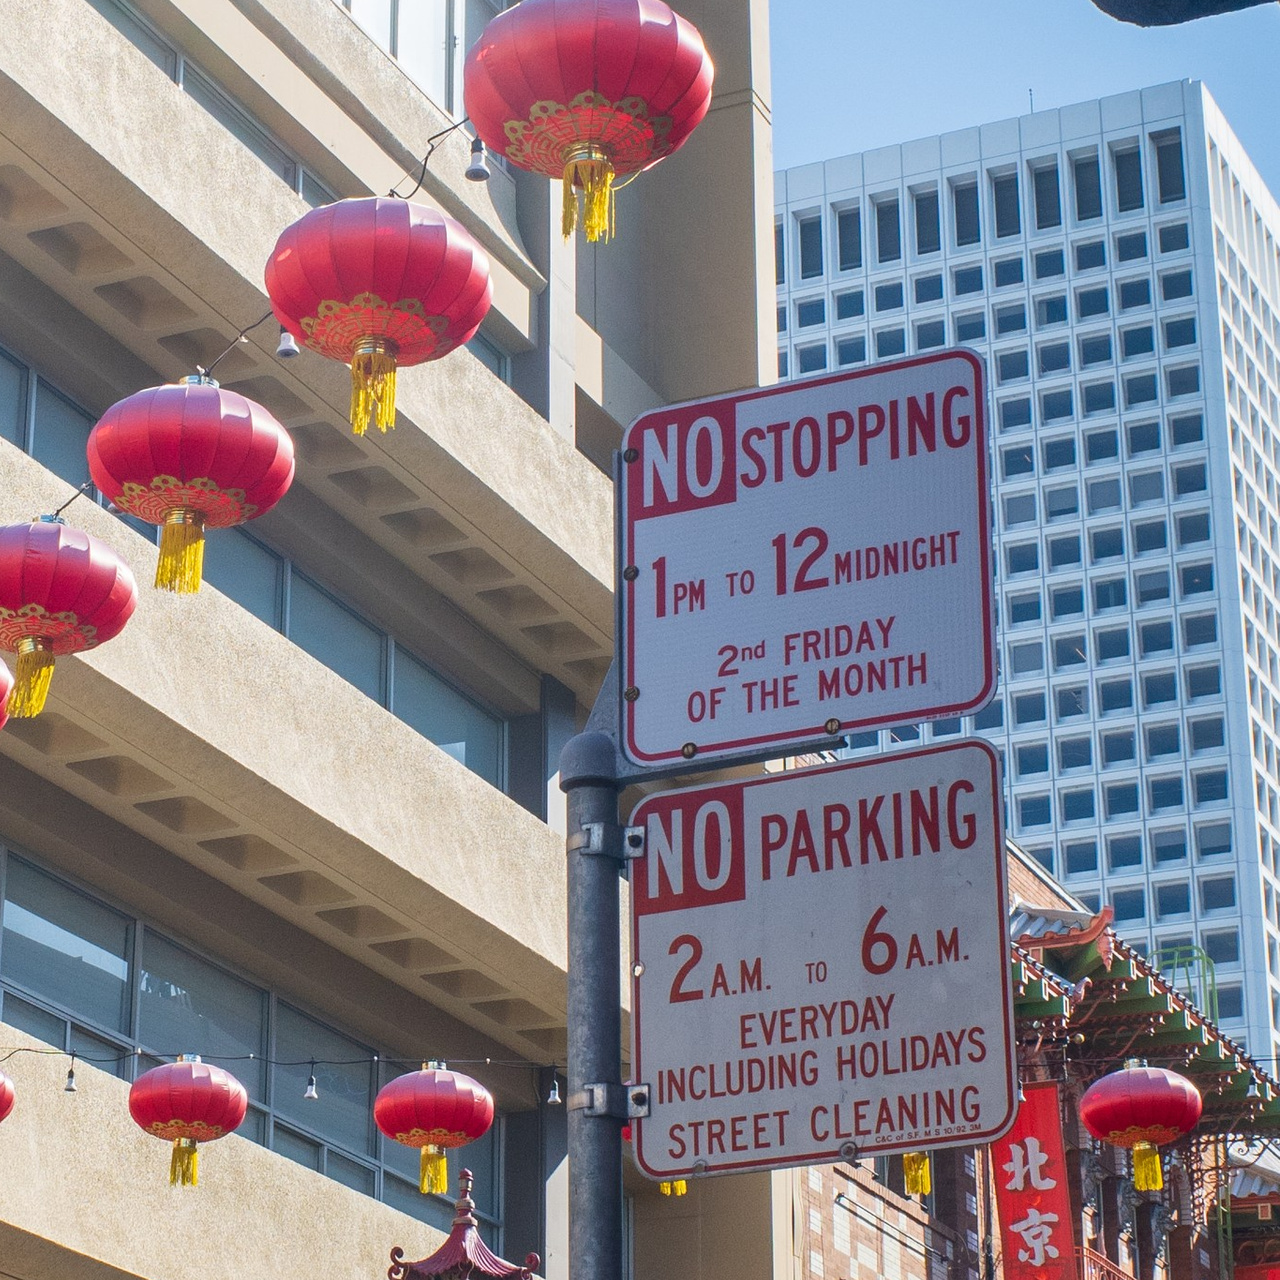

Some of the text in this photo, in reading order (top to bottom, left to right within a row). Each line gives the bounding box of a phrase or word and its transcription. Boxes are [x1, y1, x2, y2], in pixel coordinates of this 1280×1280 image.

[643, 385, 971, 508] NO STOPPING
[726, 570, 755, 596] TO
[717, 616, 896, 677] 2nd FRIDAY
[688, 652, 927, 722] OF THE MONTH
[647, 779, 977, 899] NO PARKING
[805, 962, 827, 984] TO
[740, 993, 895, 1049] EVERYDAY
[658, 1026, 987, 1105] INCLUDING HOLIDAYS
[668, 1086, 980, 1159] STREET CLEANING
